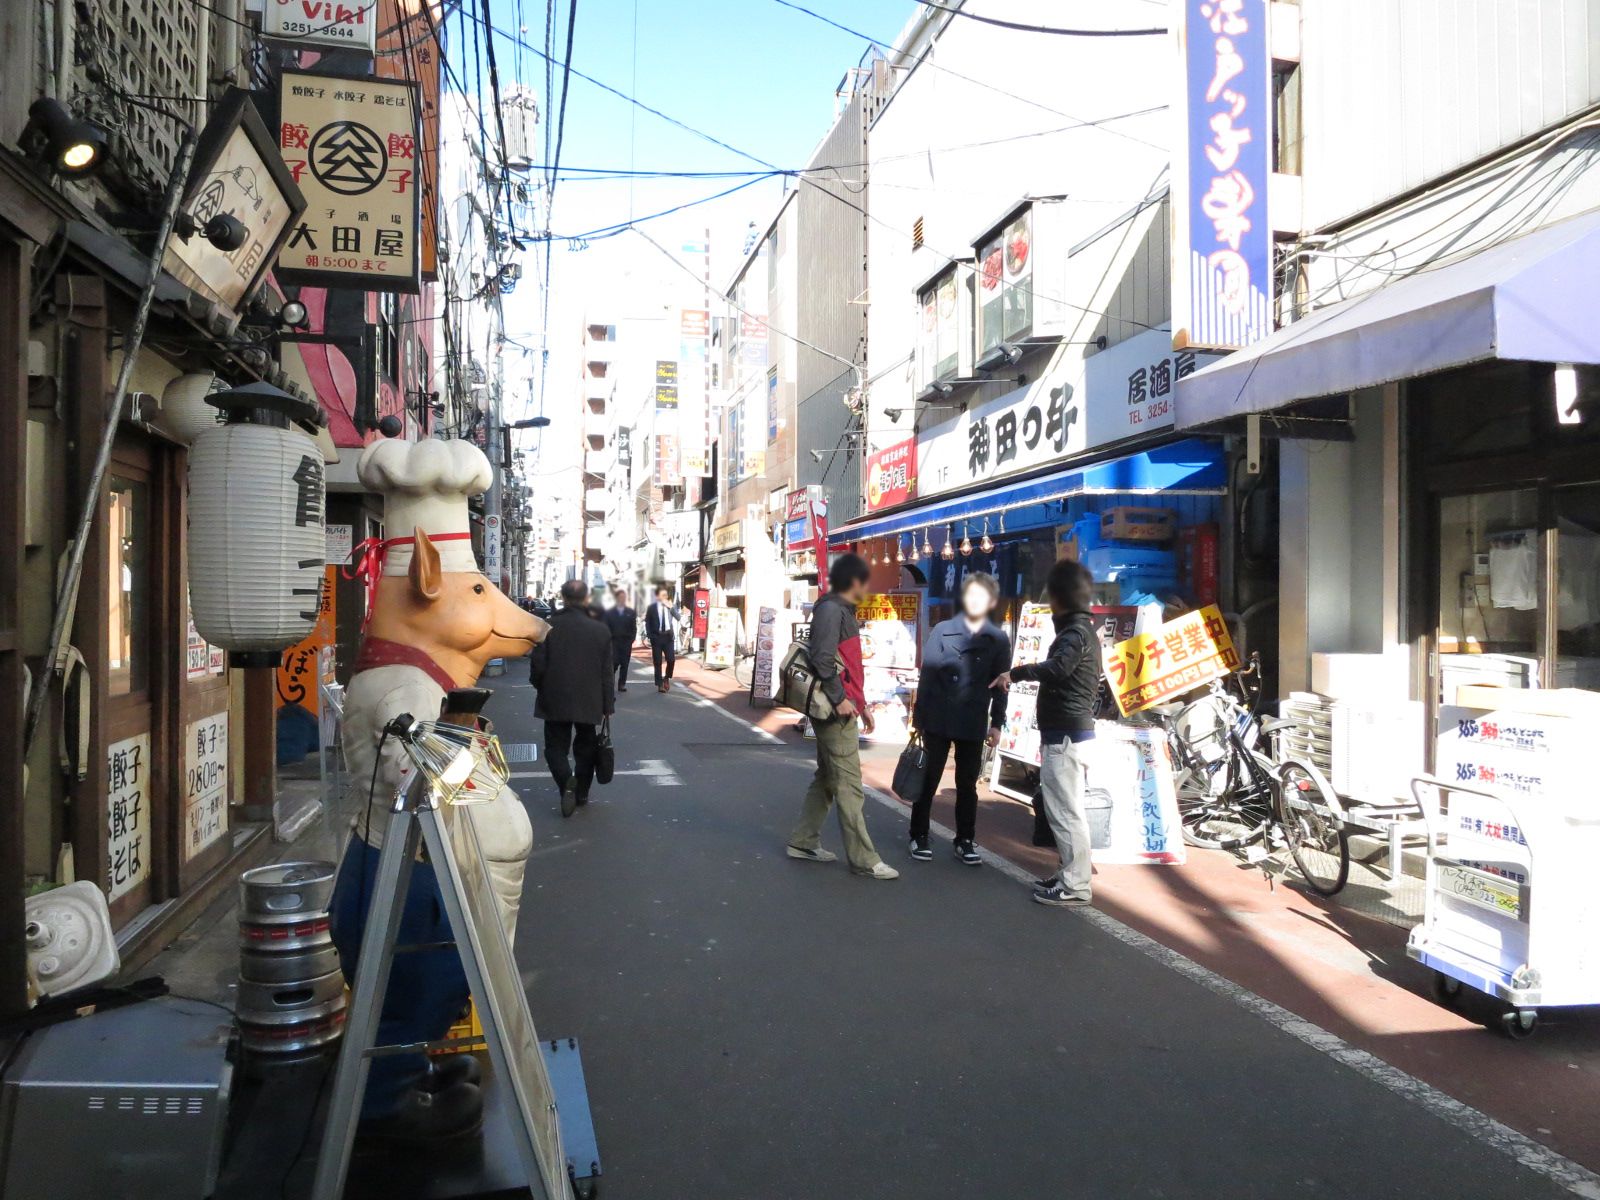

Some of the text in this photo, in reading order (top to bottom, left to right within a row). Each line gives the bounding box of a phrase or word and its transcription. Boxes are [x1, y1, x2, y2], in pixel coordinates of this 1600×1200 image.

[282, 21, 354, 37] 3251-9644
[334, 90, 366, 103] 水餃子
[281, 122, 309, 184] 餃子
[387, 133, 414, 193] 餃子
[288, 222, 404, 257] 大田屋
[1129, 410, 1143, 424] TEL
[906, 477, 916, 493] 2F
[938, 466, 948, 484] 1F
[1107, 616, 1225, 686] ランチ営業中
[198, 723, 217, 759] 餃子
